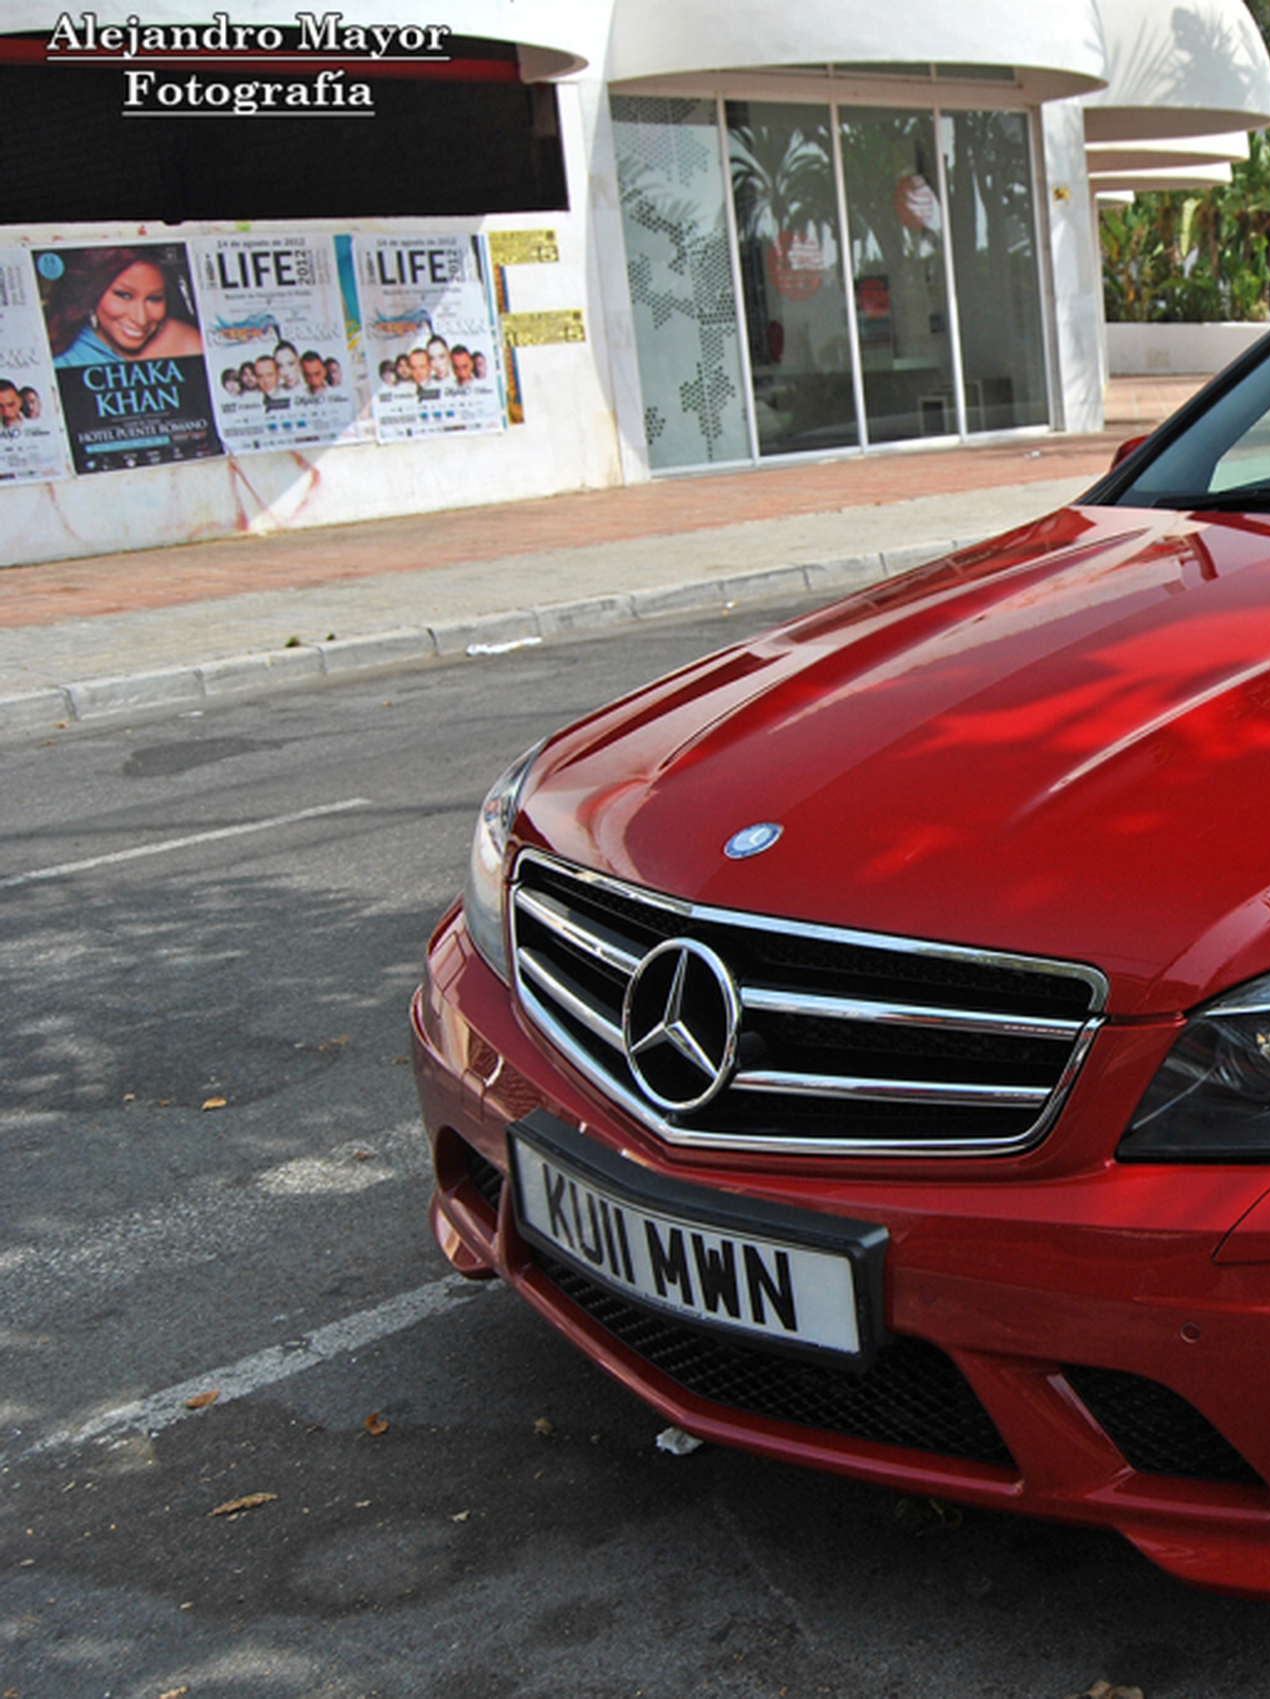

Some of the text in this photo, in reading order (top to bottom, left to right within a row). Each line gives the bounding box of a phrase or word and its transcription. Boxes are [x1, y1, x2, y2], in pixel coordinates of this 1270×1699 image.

[216, 250, 296, 289] LIFE
[295, 249, 311, 286] 2012
[377, 249, 447, 285] LIFE
[446, 248, 461, 282] 2012
[82, 359, 185, 391] CHAKA
[95, 385, 180, 418] KHAN
[78, 430, 115, 444] HOTEL
[116, 425, 157, 439] PUENTE
[159, 419, 208, 434] ROMANO
[644, 1219, 798, 1332] MWN
